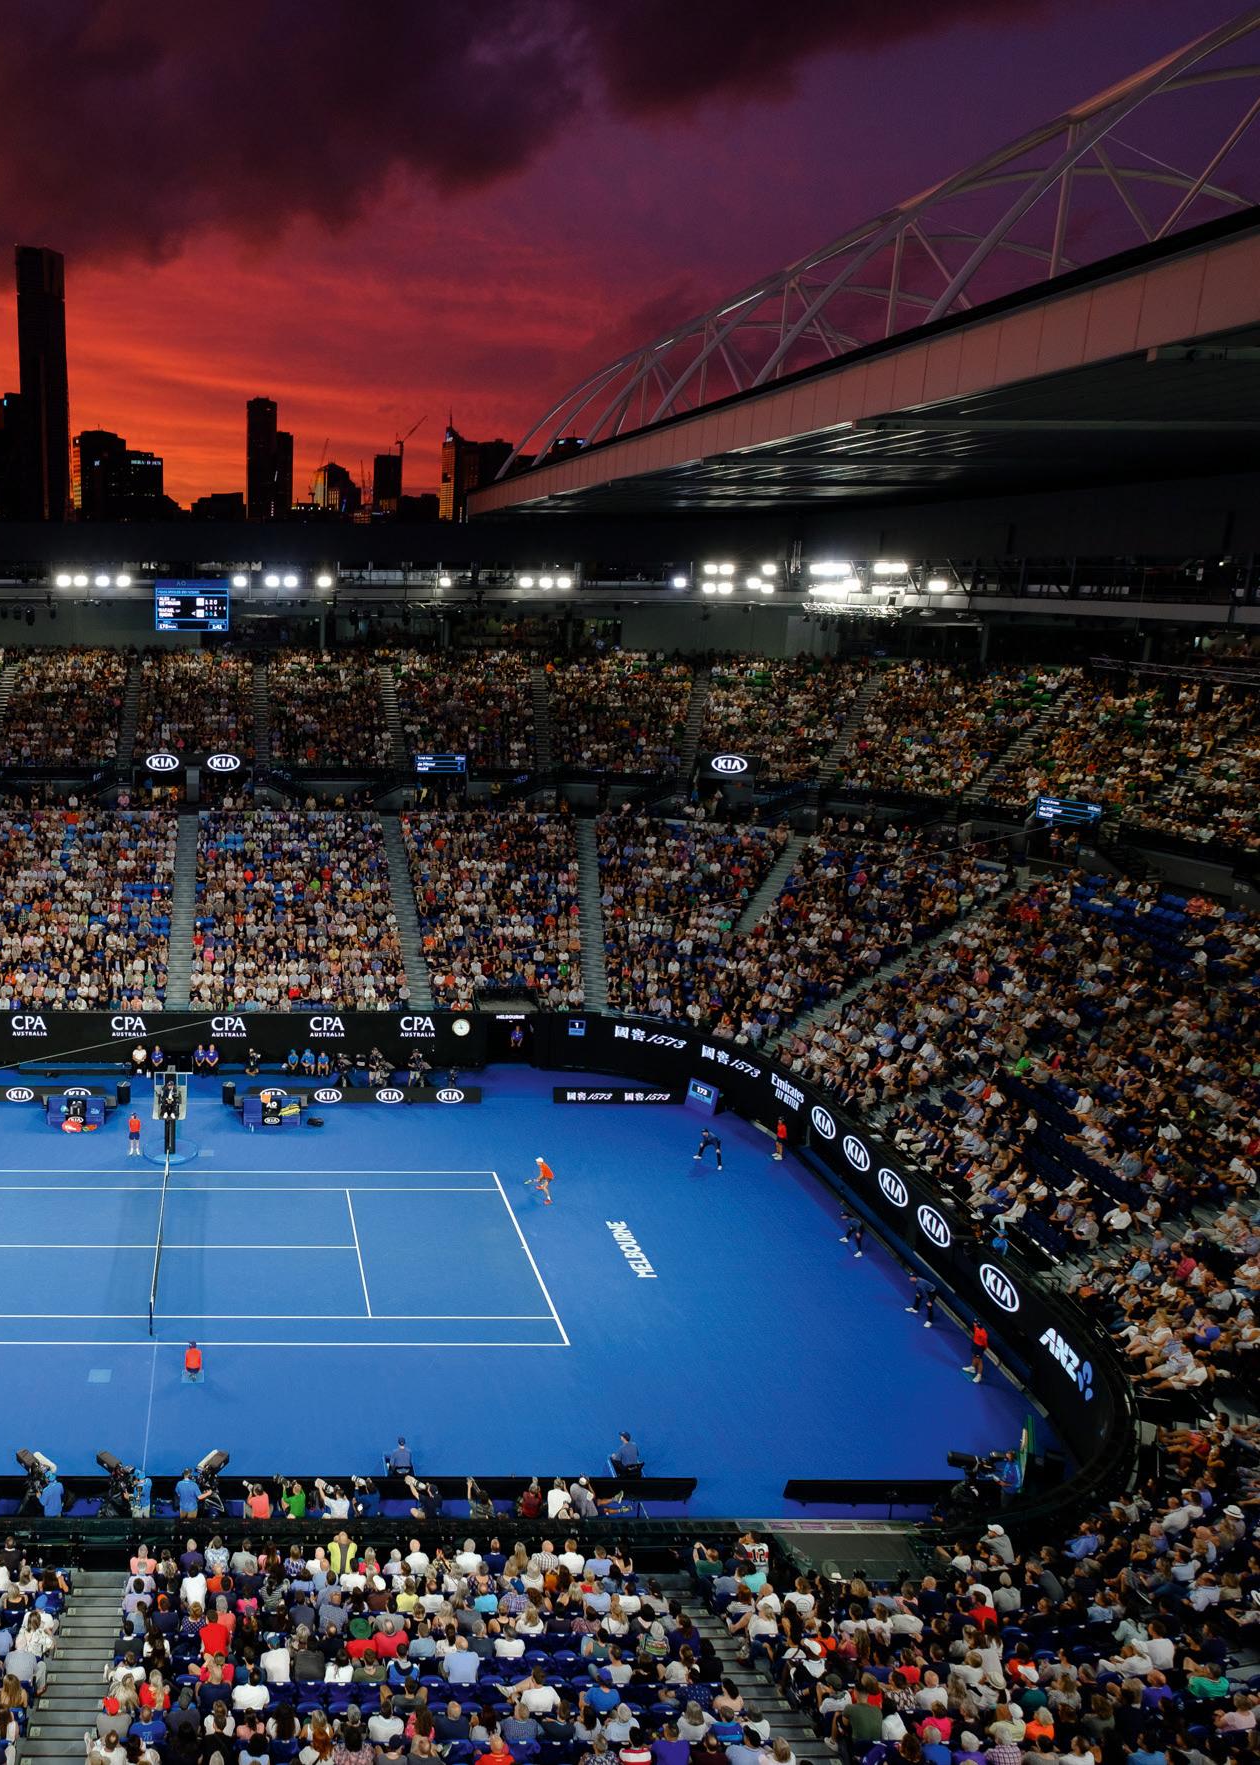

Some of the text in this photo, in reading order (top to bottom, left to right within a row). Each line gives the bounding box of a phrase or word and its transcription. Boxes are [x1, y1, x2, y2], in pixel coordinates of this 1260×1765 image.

[151, 757, 174, 768] KIA
[212, 757, 235, 768] KIA
[718, 759, 742, 770] KIA
[11, 1016, 47, 1030] CPA
[111, 1016, 147, 1031] CPA
[211, 1016, 246, 1031] CPA
[310, 1017, 345, 1031] CPA
[400, 1017, 435, 1031] CPA
[771, 1073, 804, 1103] Emirates
[775, 1088, 799, 1111] FLY BETTER
[816, 1110, 831, 1136] KIA
[848, 1141, 864, 1168] KIA
[883, 1172, 902, 1203] KIA
[922, 1209, 944, 1243] KIA
[605, 1220, 658, 1278] MELBOURNE
[986, 1267, 1012, 1308] KIA
[1039, 1328, 1080, 1382] ANZ
[752, 1548, 765, 1562] 12
